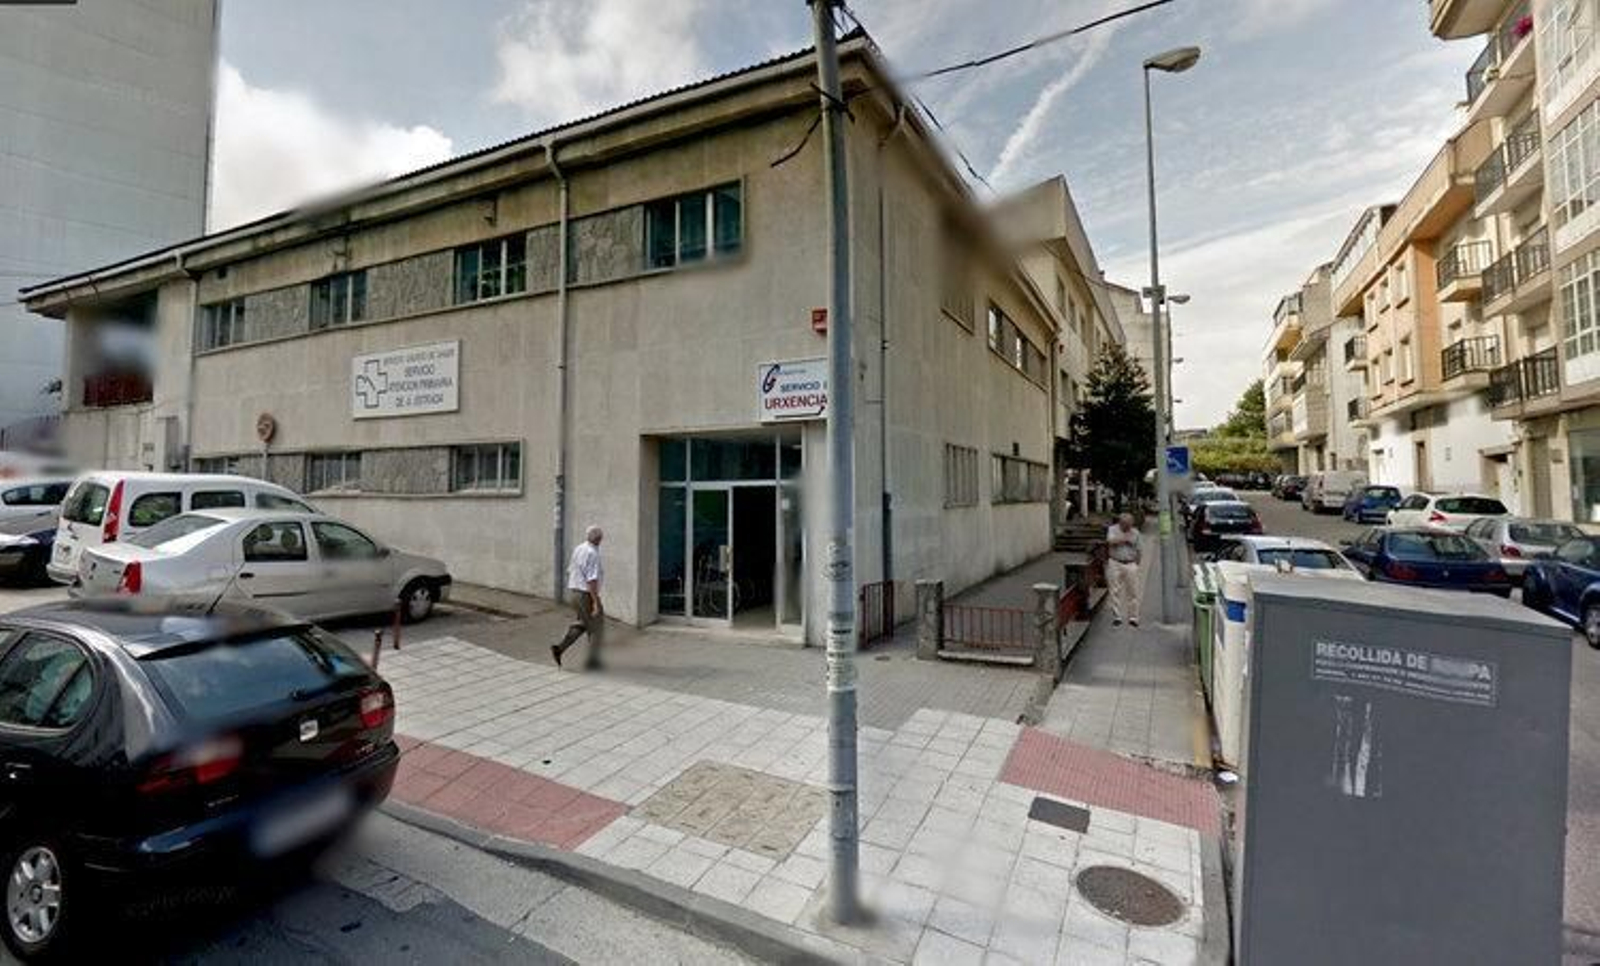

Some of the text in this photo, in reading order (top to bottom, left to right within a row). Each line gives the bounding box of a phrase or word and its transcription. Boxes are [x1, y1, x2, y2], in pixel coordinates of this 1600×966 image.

[780, 381, 821, 393] SERVICIO
[1315, 642, 1402, 666] RECOLLIDA
[1406, 653, 1428, 671] DE
